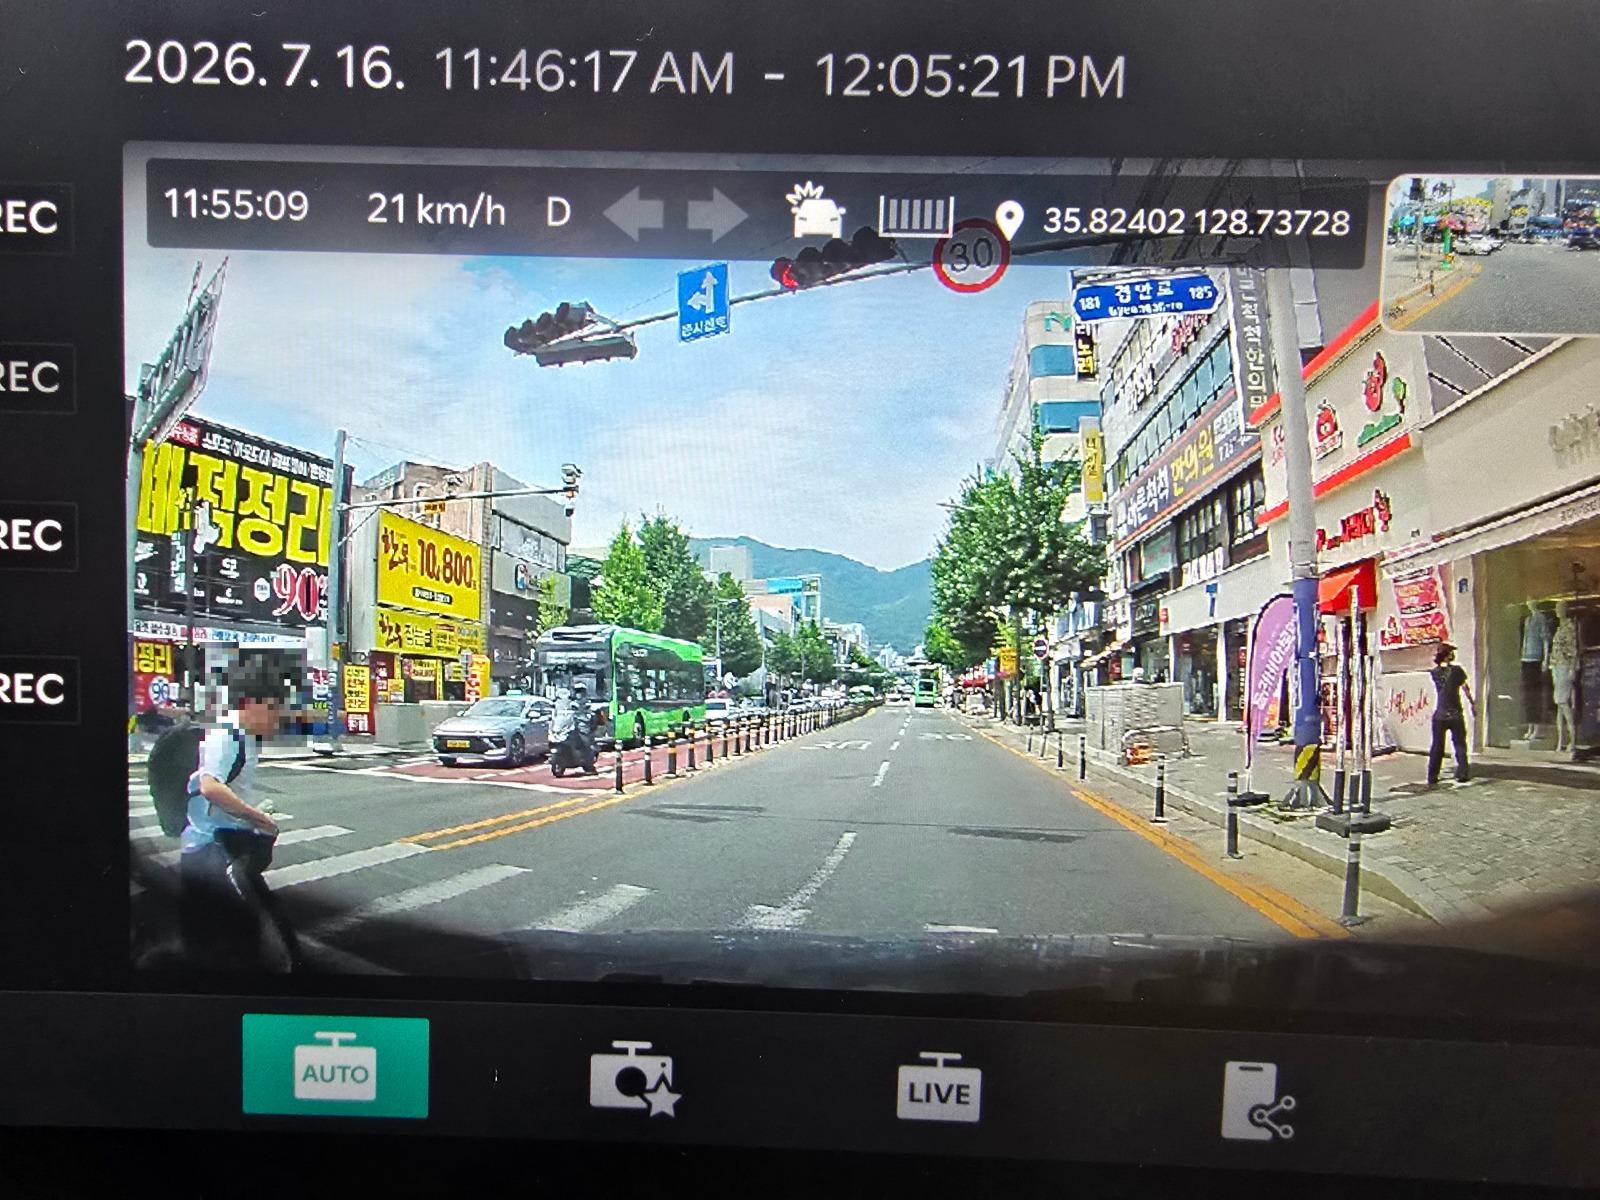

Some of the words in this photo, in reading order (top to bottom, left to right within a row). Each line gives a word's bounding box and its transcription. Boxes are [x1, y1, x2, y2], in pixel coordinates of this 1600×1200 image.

[125, 40, 267, 87] 2026.
[282, 43, 319, 88] 7.
[337, 45, 405, 90] 16.
[436, 48, 637, 93] 11:46:17
[650, 51, 734, 95] AM
[816, 53, 1025, 98] 12:05:21
[1047, 55, 1126, 99] PM
[0, 200, 58, 235] EC
[164, 187, 309, 222] 11:55:09
[367, 192, 404, 224] 21
[417, 191, 506, 229] km/h
[547, 196, 572, 227] D
[1043, 207, 1185, 234] 35.82402
[1195, 209, 1350, 236] 128.73728
[949, 237, 993, 272] 30
[1079, 296, 1100, 310] 181
[1114, 280, 1174, 303] 경안로
[1189, 286, 1213, 300] 185
[0, 361, 60, 393] EC
[302, 1064, 370, 1085] AUTO
[908, 1081, 971, 1106] LIVE
